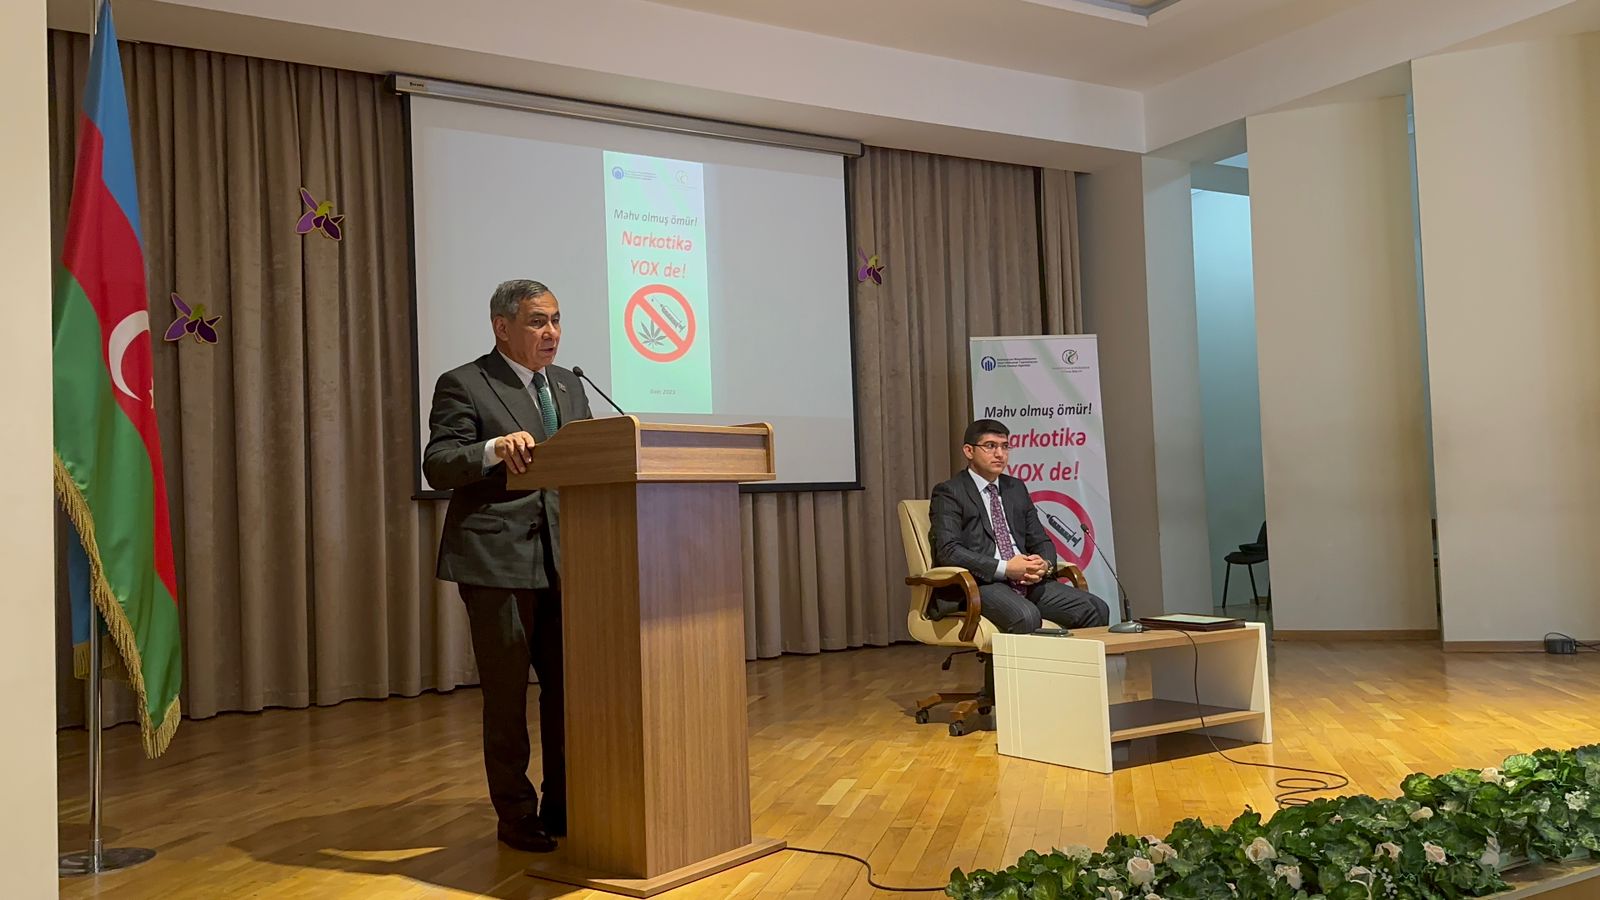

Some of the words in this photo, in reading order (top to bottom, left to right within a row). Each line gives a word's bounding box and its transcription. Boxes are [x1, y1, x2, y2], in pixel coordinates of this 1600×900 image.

[641, 212, 668, 226] olmuş
[671, 215, 698, 226] ömür!
[621, 231, 692, 251] Narkotikə
[631, 260, 659, 276] YOX
[664, 262, 687, 279] de!
[984, 405, 1017, 418] Məhv
[1020, 404, 1054, 419] olmuş
[1057, 403, 1092, 416] ömür!
[1008, 427, 1086, 448] arkotikə
[1007, 463, 1044, 481] YOX
[1049, 461, 1080, 481] de!
